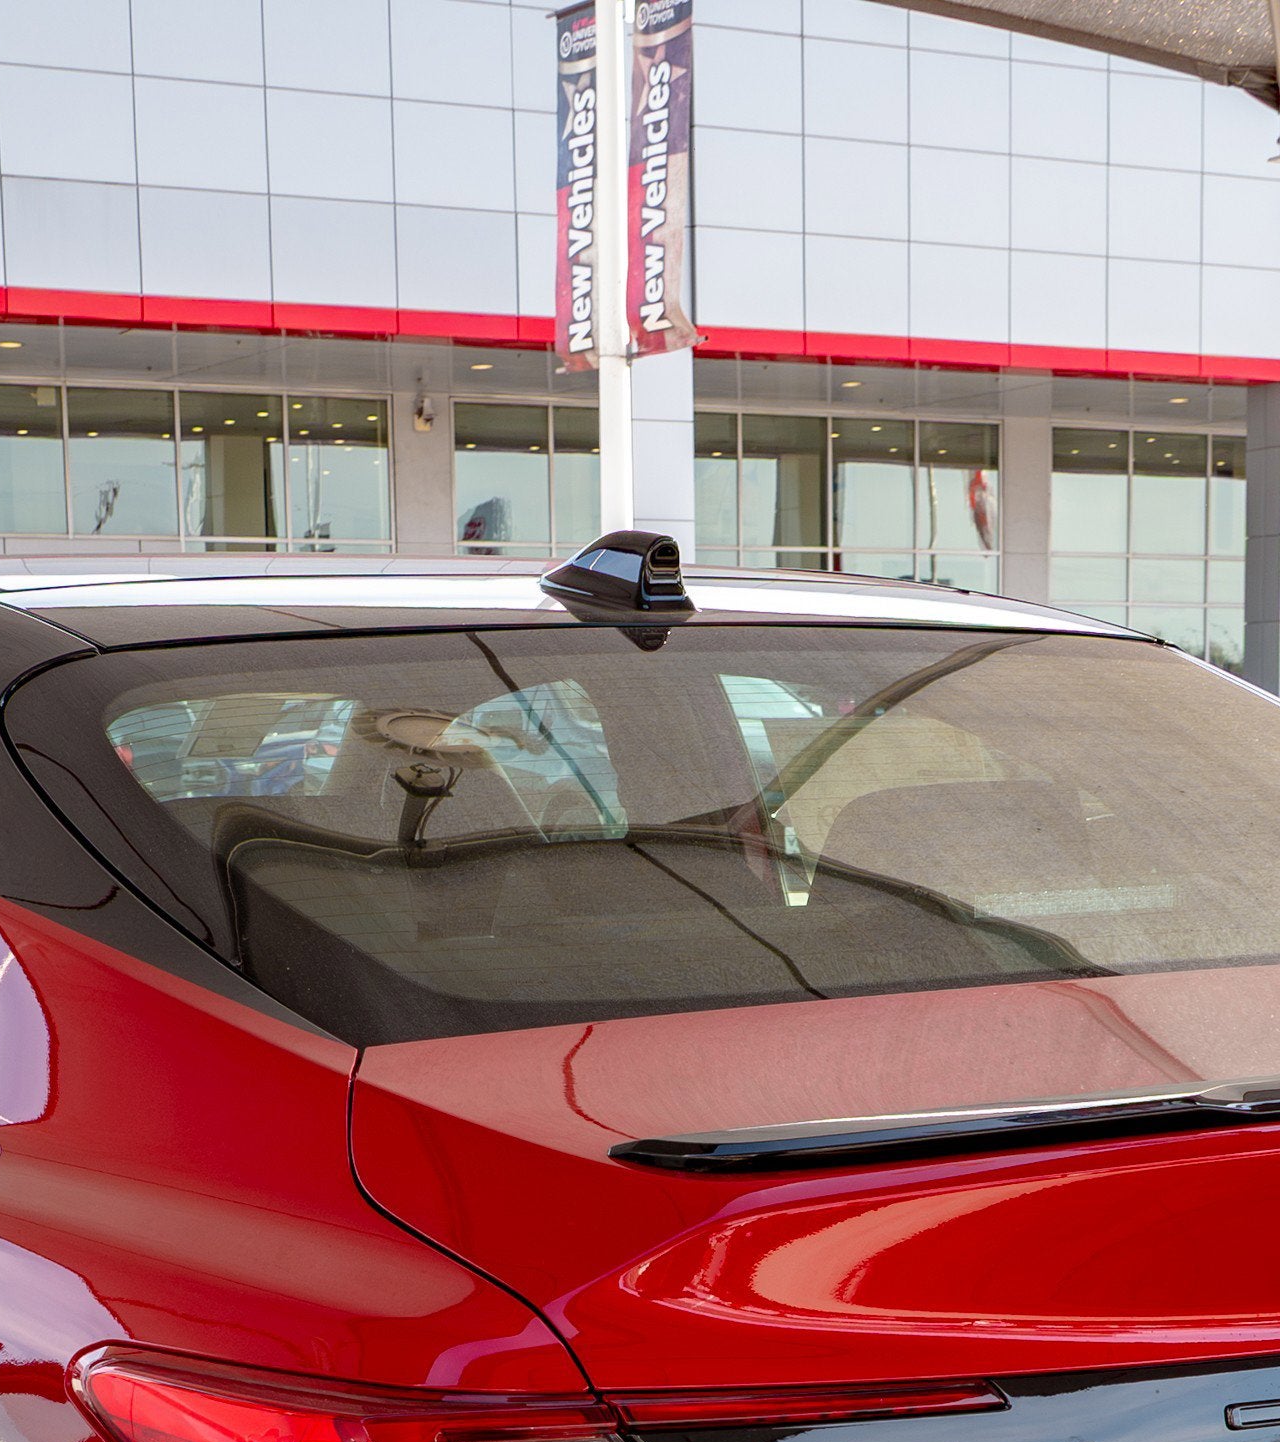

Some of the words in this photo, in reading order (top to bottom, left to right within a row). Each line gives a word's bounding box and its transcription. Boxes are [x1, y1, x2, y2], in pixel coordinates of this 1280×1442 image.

[568, 86, 596, 259] Vehicles
[641, 60, 670, 238] Vehicles
[569, 264, 595, 354] New
[640, 245, 673, 334] New
